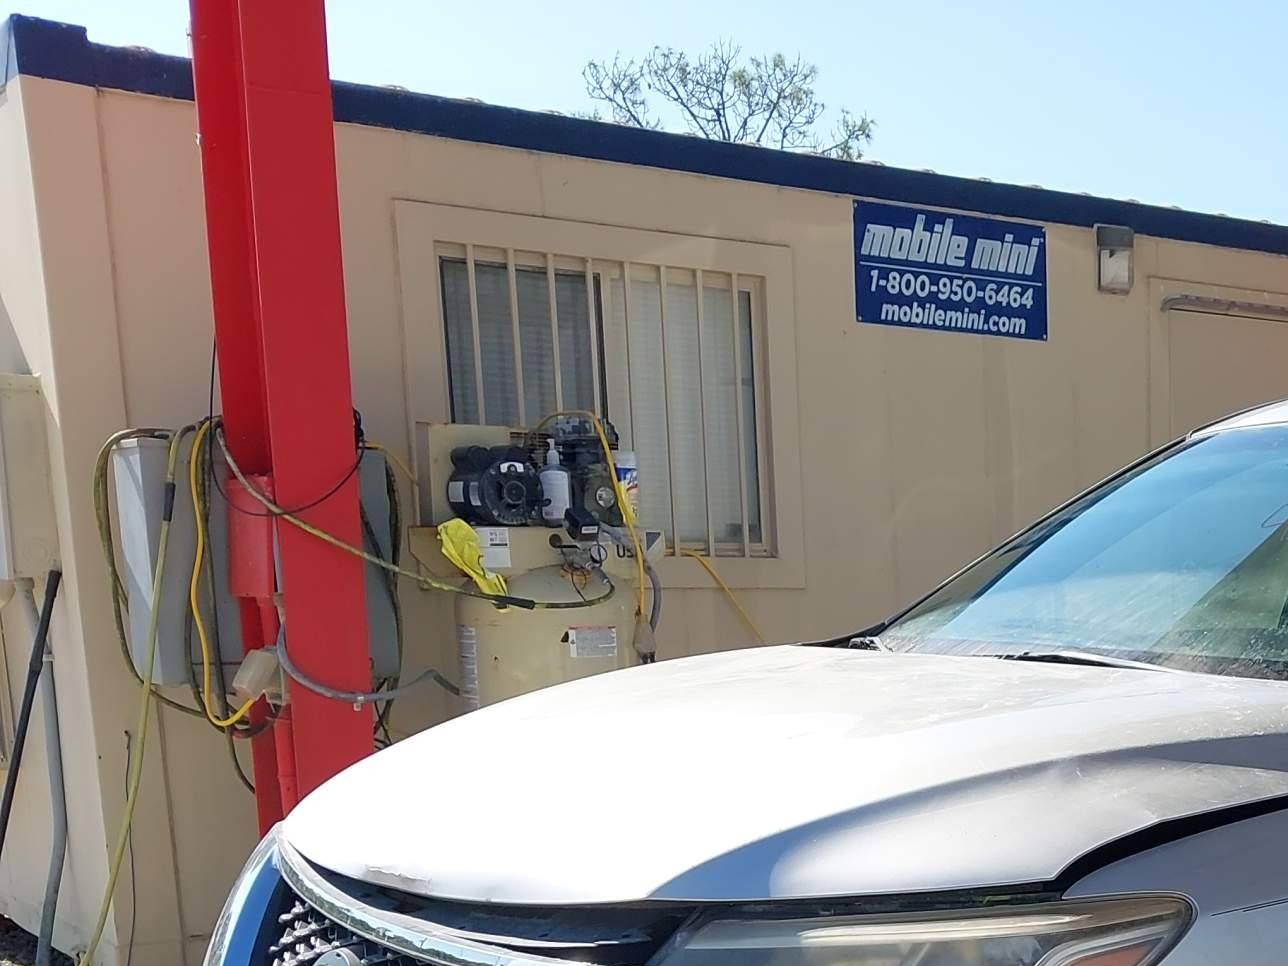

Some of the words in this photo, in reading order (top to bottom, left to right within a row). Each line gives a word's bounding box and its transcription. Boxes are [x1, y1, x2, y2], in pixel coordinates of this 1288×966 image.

[860, 214, 969, 267] mobile
[970, 233, 1040, 276] mini
[870, 269, 1034, 310] 1-800-950-6464
[880, 301, 1027, 335] mobilemini.com
